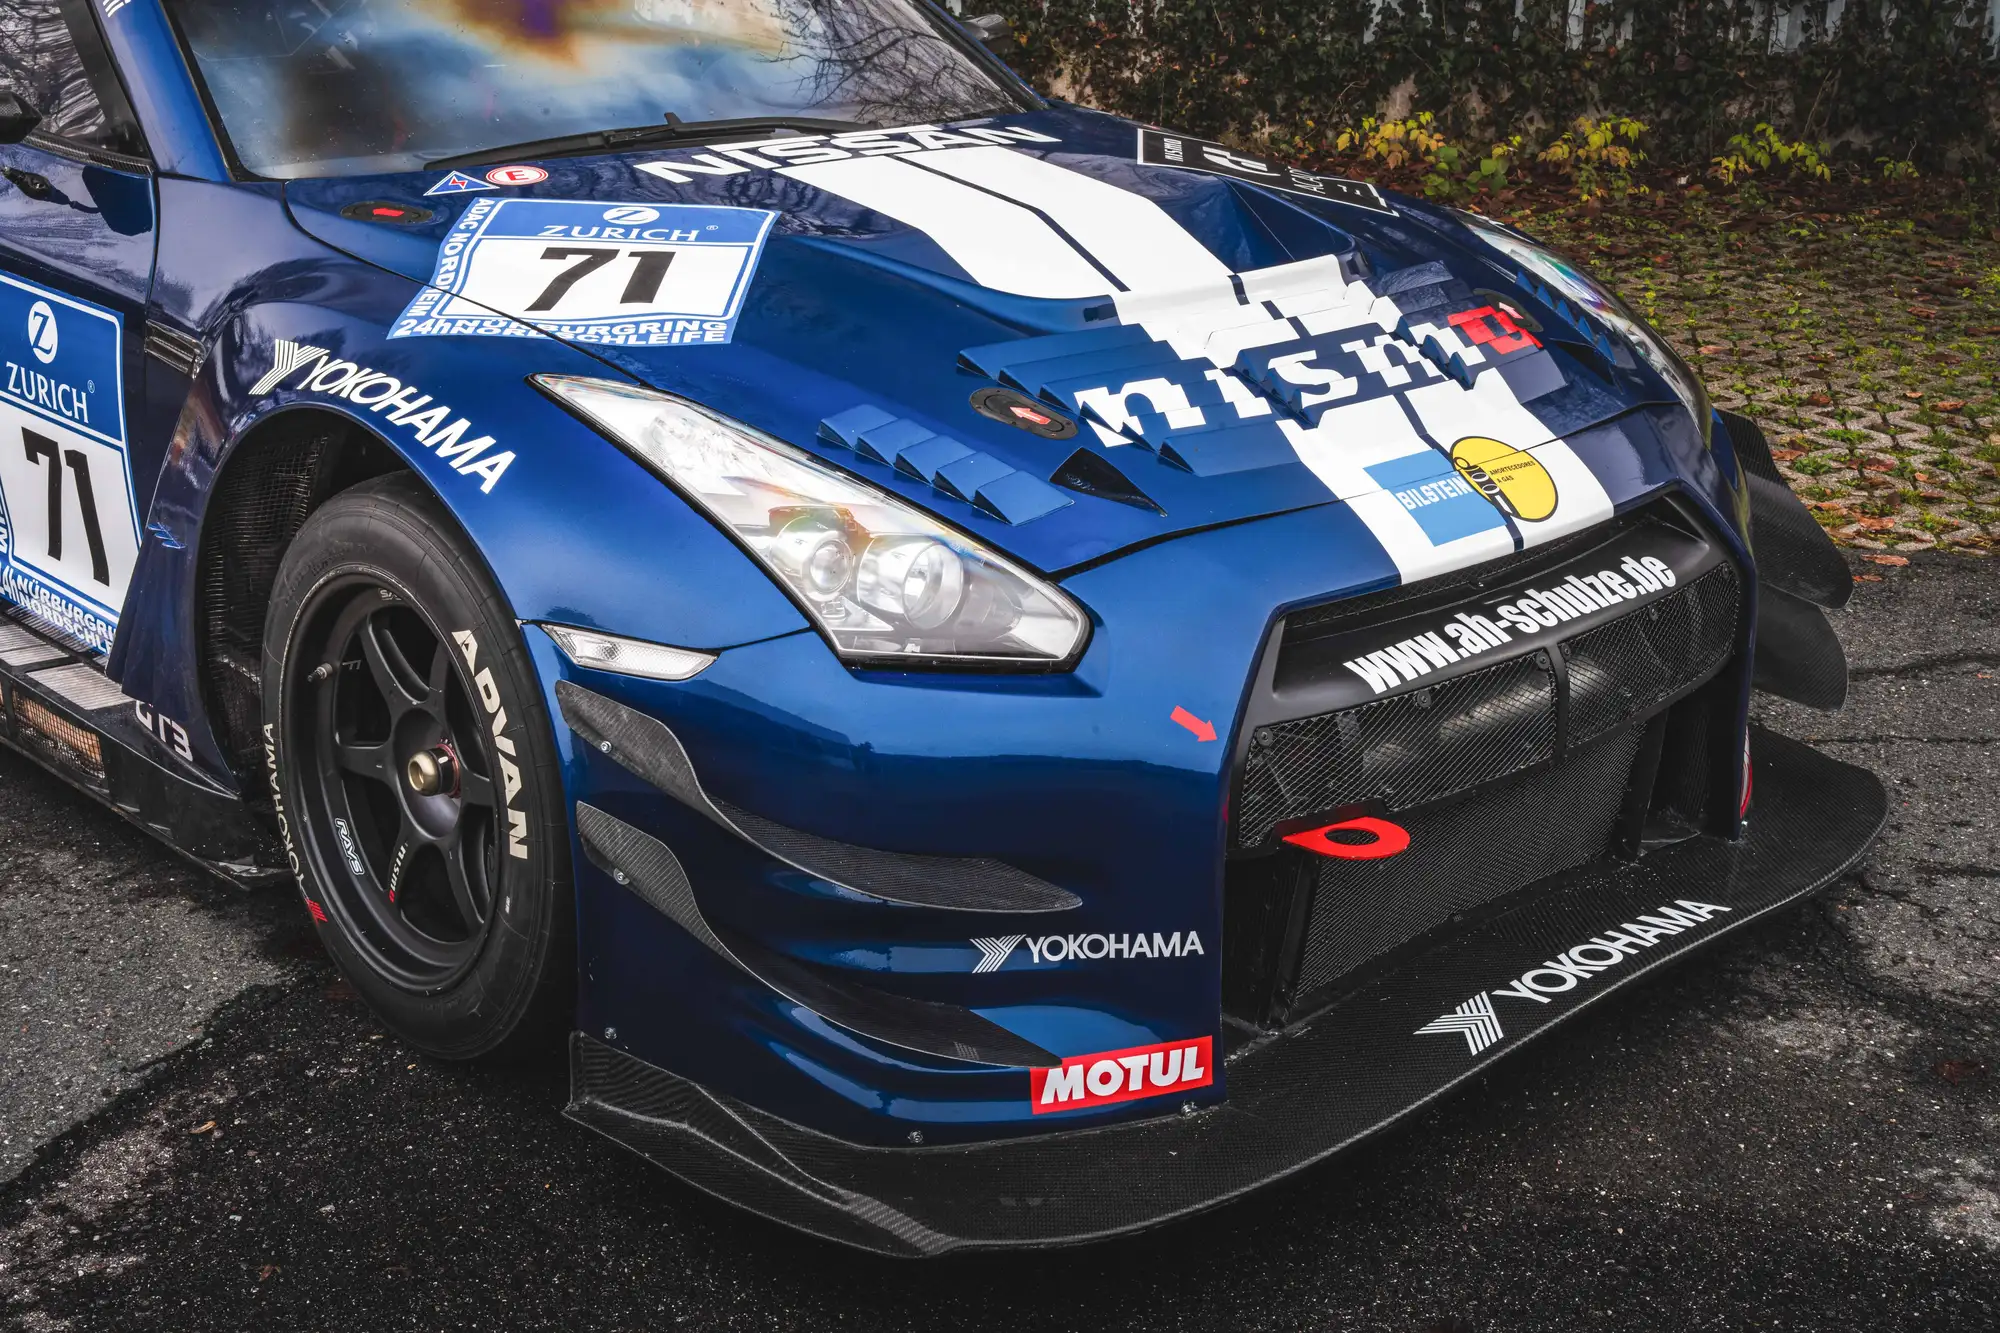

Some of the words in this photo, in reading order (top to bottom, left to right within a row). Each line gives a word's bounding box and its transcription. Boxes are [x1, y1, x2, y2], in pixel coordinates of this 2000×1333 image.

[505, 169, 529, 182] E
[634, 124, 1062, 185] NISSAN
[458, 198, 496, 232] ADAC
[537, 225, 700, 242] ZURICH
[523, 246, 677, 312] 71
[392, 318, 451, 338] 24h
[5, 360, 89, 424] ZURICH
[301, 355, 517, 495] YOKOHAMA
[20, 426, 110, 587] 71
[1396, 475, 1474, 510] BILSTEIN
[1343, 556, 1677, 694] www.ah-schulze.de
[135, 699, 194, 762] GT3
[451, 629, 528, 860] ADVAN
[263, 723, 310, 901] YOKOHAMA
[334, 818, 365, 876] RAYS
[1026, 929, 1206, 964] YOKOHAMA
[1494, 898, 1733, 1008] YOKOHAMA
[1039, 1046, 1205, 1107] MOTUL
